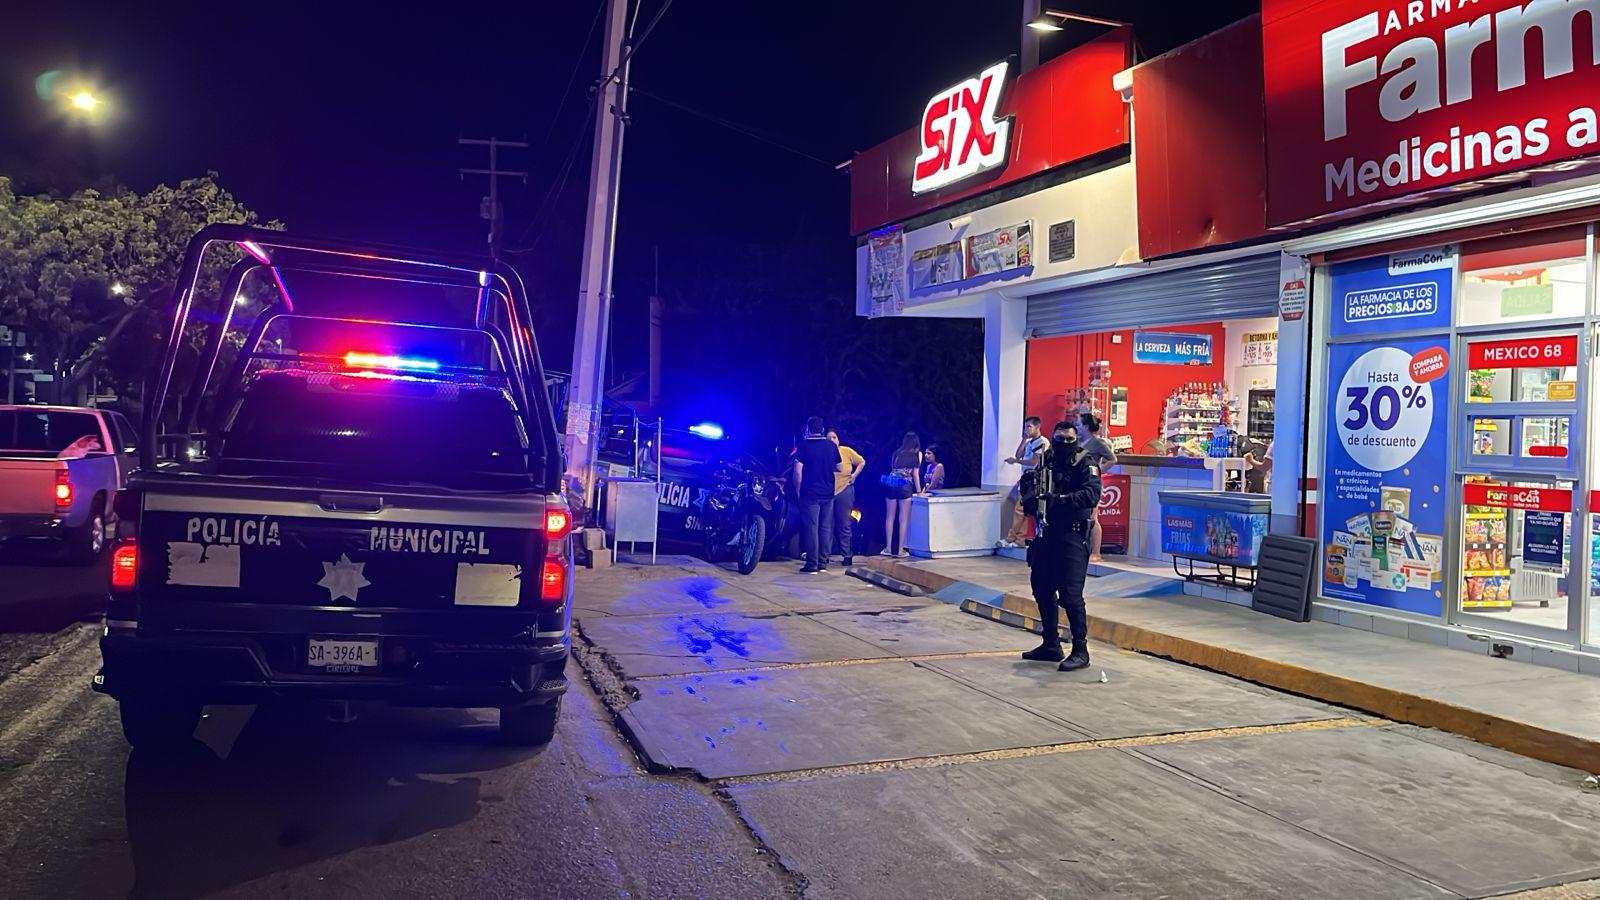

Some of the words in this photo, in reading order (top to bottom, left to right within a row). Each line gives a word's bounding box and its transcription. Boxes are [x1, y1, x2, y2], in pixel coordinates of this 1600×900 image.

[1324, 117, 1550, 202] Medicinas
[1566, 106, 1598, 148] a
[1349, 296, 1359, 306] LA
[1360, 291, 1401, 303] FARMACIA
[1403, 289, 1415, 300] DE
[1416, 287, 1433, 298] LOS
[1349, 303, 1393, 318] PRECIOS
[1395, 298, 1432, 313] BAJOS
[1135, 343, 1143, 352] LA
[1144, 343, 1171, 353] CERVEZA
[1175, 341, 1191, 355] MÁS
[1193, 342, 1210, 356] FRÍA
[1484, 345, 1539, 361] MEXICO
[1543, 344, 1562, 358] 68
[1412, 354, 1443, 370] COMPARA
[1420, 362, 1444, 375] AHORRA
[1367, 371, 1399, 383] Hasta
[1343, 385, 1427, 431] 30%
[1347, 434, 1360, 446] de
[1362, 434, 1417, 448] descuento
[1342, 470, 1382, 478] medicamentos
[658, 481, 690, 508] LÍCIA
[1340, 485, 1380, 493] especialidades
[1098, 508, 1121, 516] LANDA
[187, 516, 281, 546] POLICÍA
[685, 515, 703, 531] SIN
[369, 526, 490, 555] MUNICIPAL
[309, 645, 378, 661] SA-396A-1
